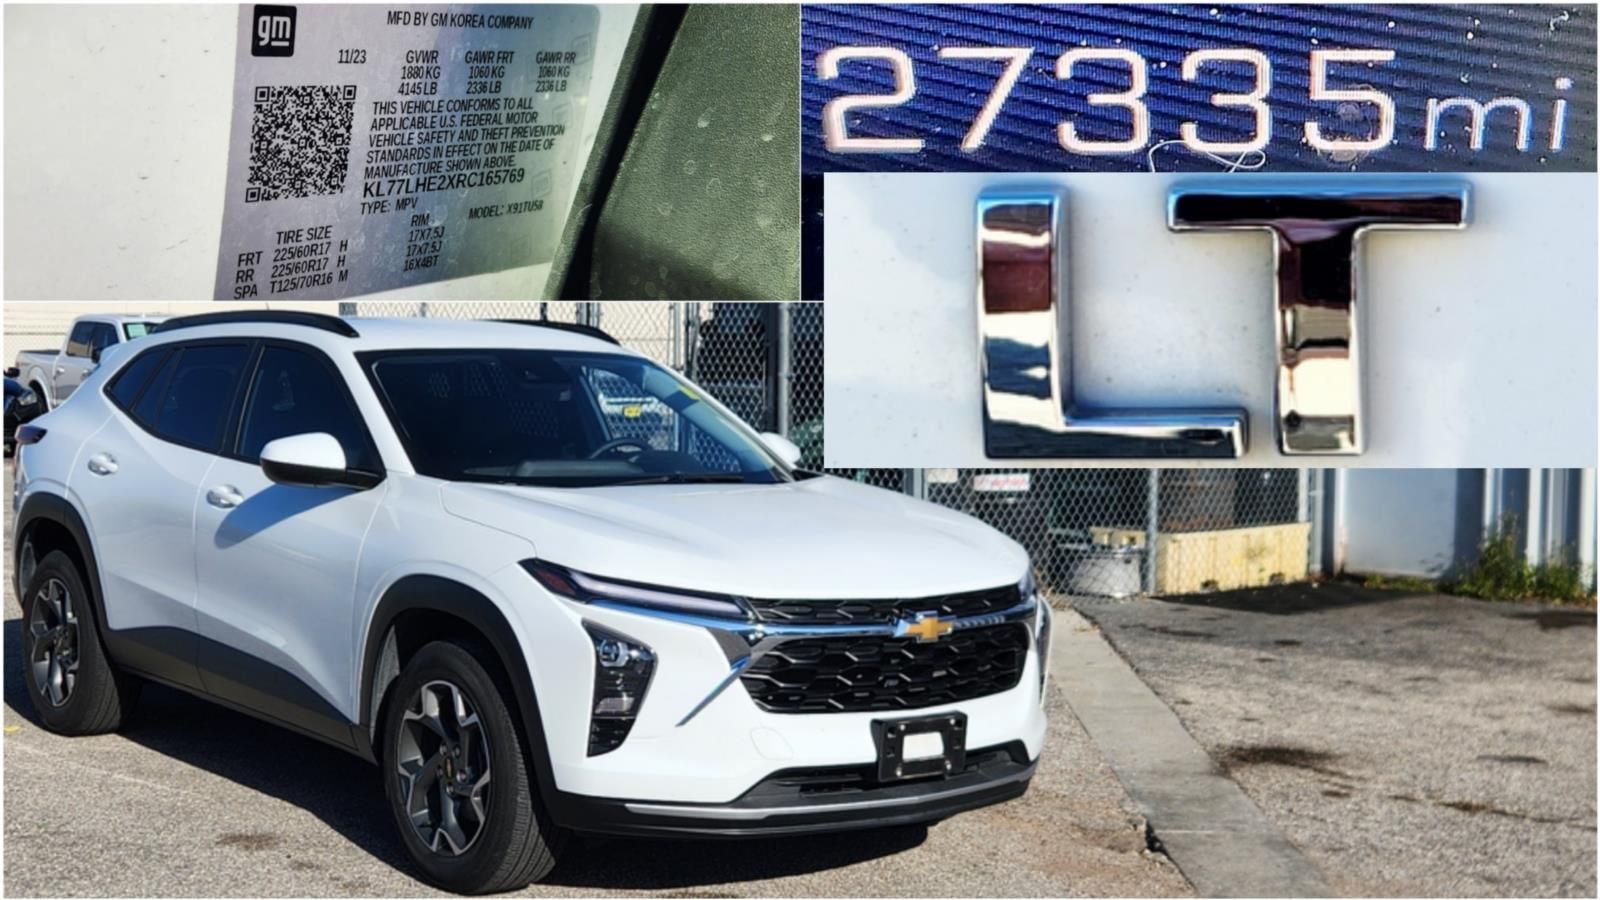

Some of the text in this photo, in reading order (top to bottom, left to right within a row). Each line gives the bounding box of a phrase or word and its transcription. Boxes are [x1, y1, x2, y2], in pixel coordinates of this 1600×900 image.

[387, 11, 534, 29] MFD BY GM KOREA COMPANY
[258, 15, 291, 47] gm
[337, 49, 367, 64] 11/23
[406, 50, 439, 64] GVWR
[465, 51, 514, 64] GAWR FRT
[536, 51, 576, 63] GAWR RR
[401, 66, 440, 79] 1880 KG
[468, 67, 505, 79] 1060 KG
[538, 66, 570, 78] 1060 KG
[398, 82, 437, 95] 4145 LB
[466, 82, 501, 94] 2336 LB
[535, 81, 567, 93] 2336 LB
[373, 97, 534, 115] THIS VEHICLE CONFORMS TO ALL
[816, 46, 1572, 154] 27335 mi
[370, 111, 539, 131] APPLICABLE U.S. FEDERAL MOTOR
[369, 124, 566, 148] VEHICLE SAFETY AND THEFT PREVENTION
[366, 137, 556, 164] STANDARDS IN EFFECT ON THE DATE OF
[364, 160, 443, 180] MANUFACTURE
[446, 157, 481, 173] SHOWN
[363, 167, 526, 199] KL77LHE2XRC165769
[360, 197, 419, 215] TYPE: MPV
[468, 204, 505, 219] MODEL:
[410, 214, 430, 227] RIM
[276, 225, 333, 245] TIRE SIZE
[408, 226, 445, 243] 17X7.5J
[237, 239, 349, 267] FRT 225/60R17 H
[235, 254, 346, 284] RR 225/60R17 H
[403, 255, 440, 273] 16X4BT
[233, 269, 349, 300] SPA T125/70R16 M
[977, 181, 1474, 459] LT
